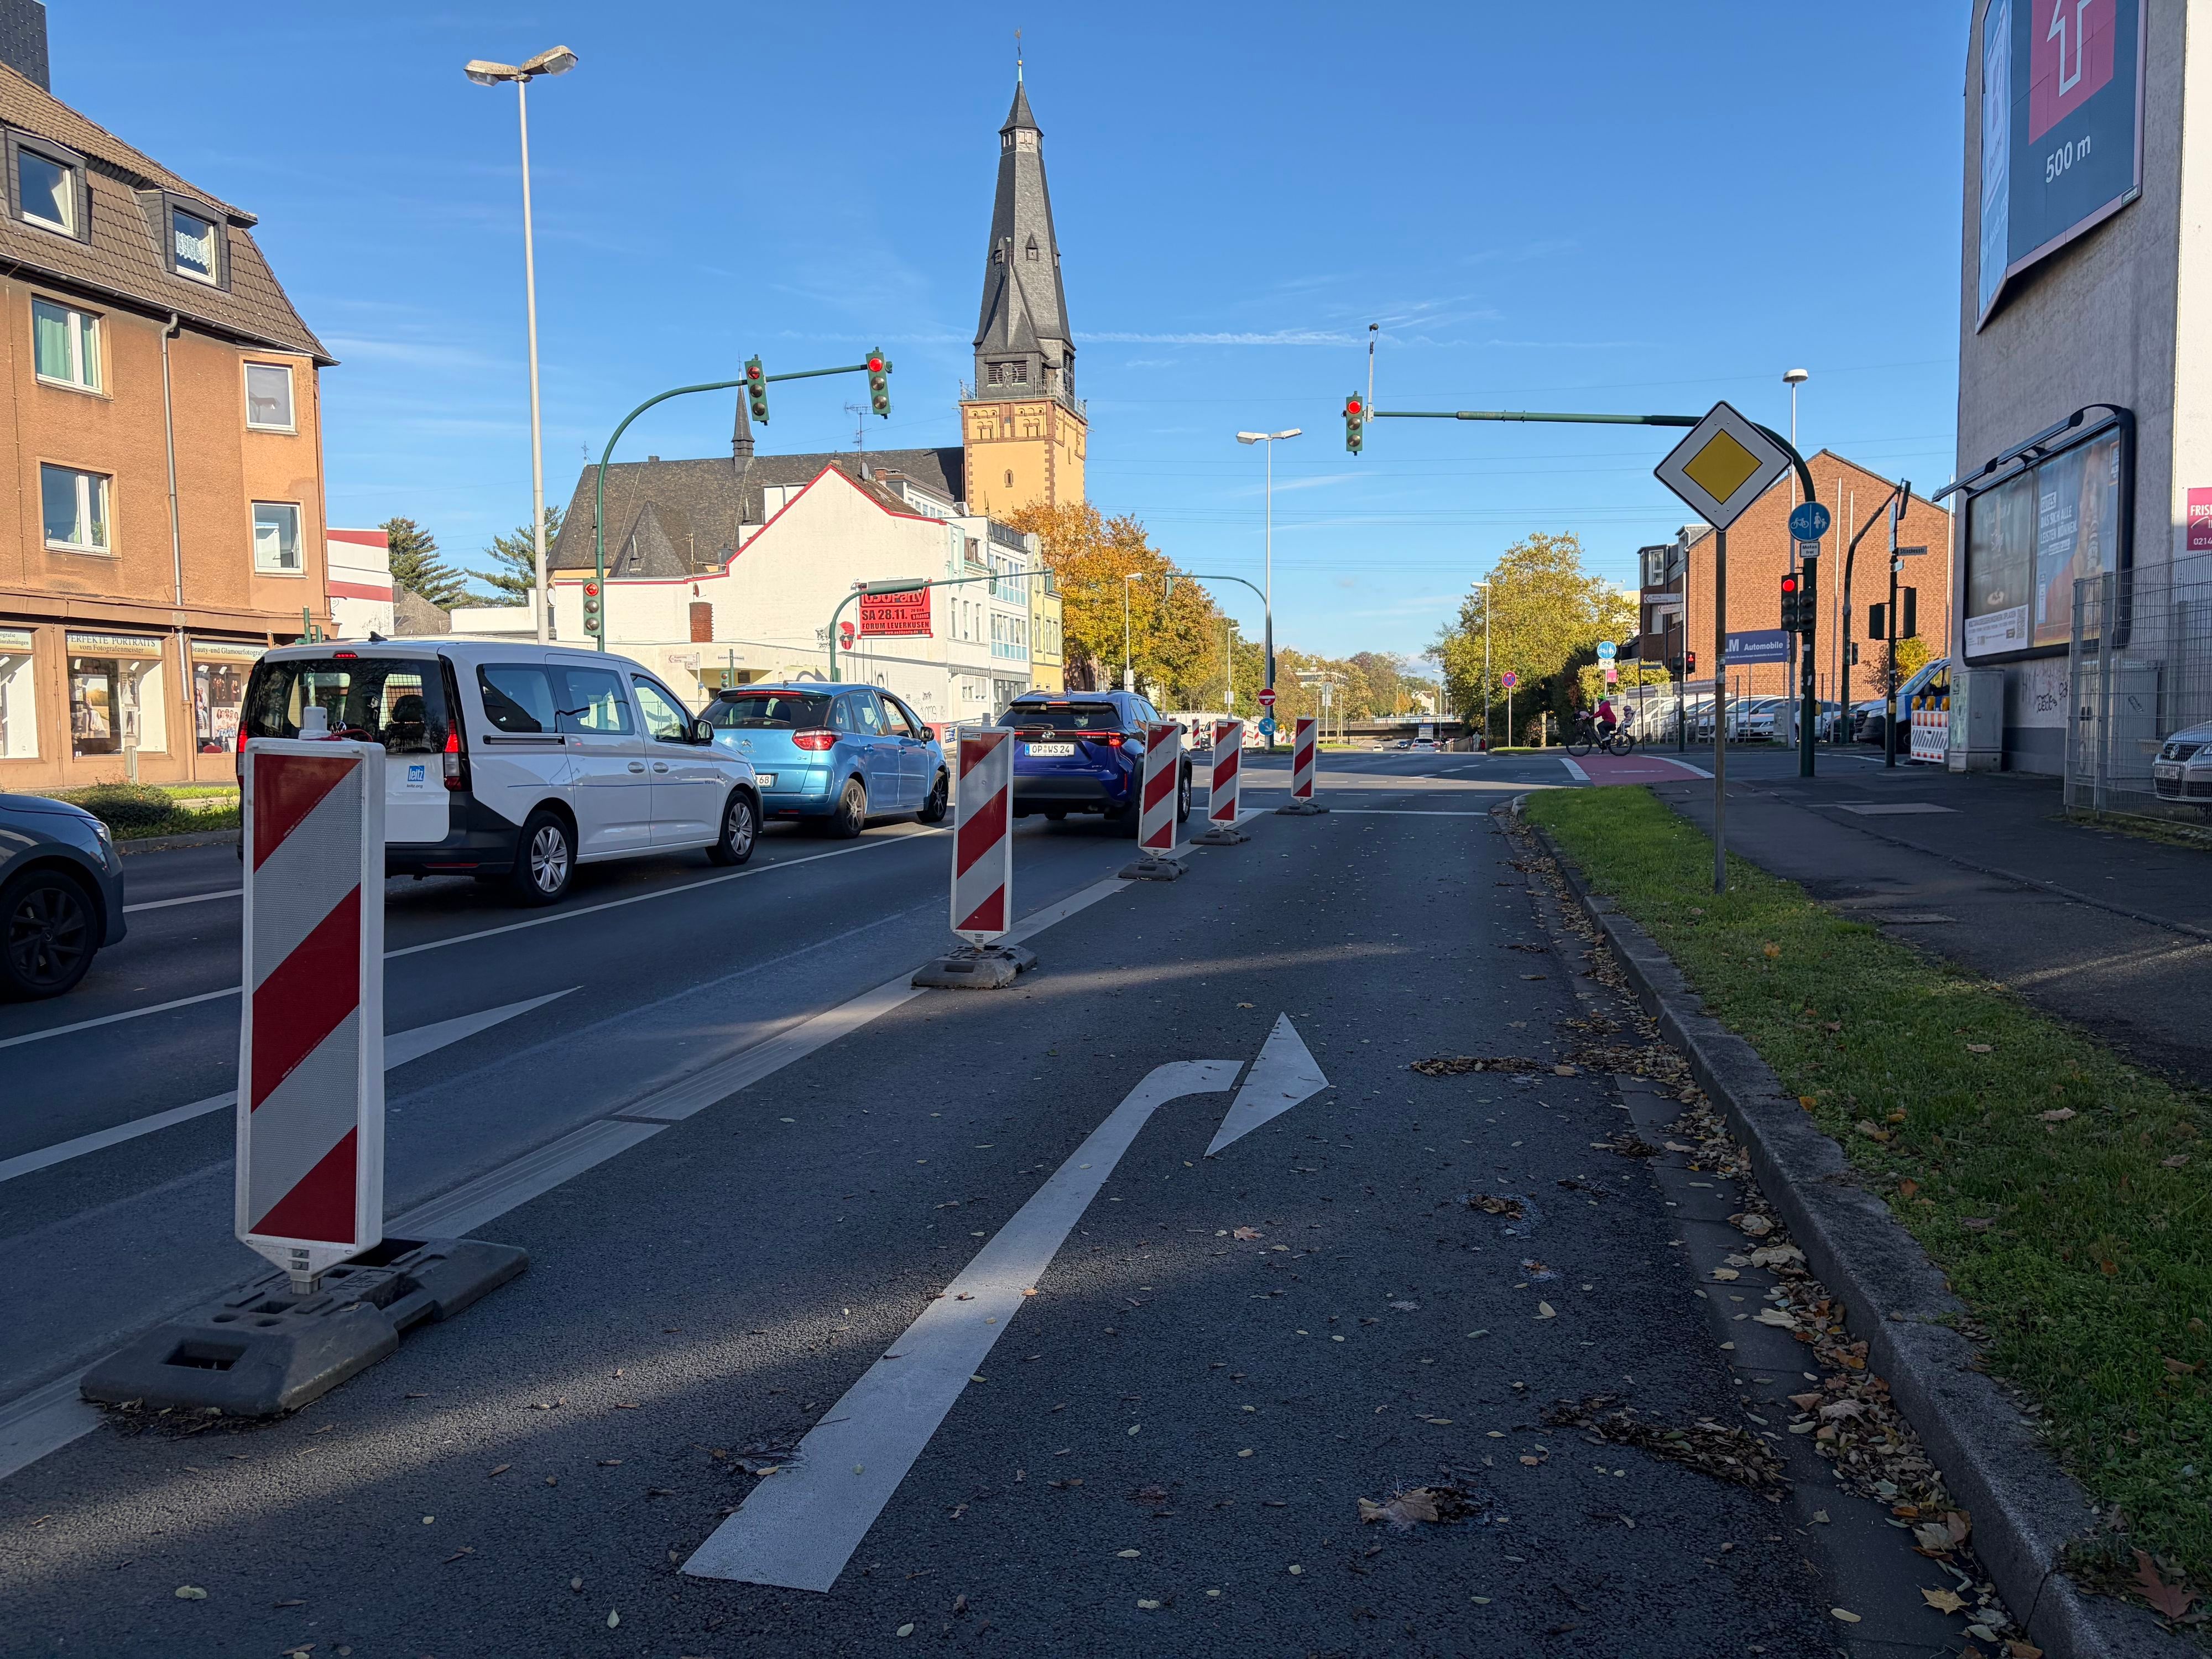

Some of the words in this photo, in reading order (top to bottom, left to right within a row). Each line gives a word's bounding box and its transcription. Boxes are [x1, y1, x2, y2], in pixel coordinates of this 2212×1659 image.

[2046, 142, 2073, 184] 500
[2077, 135, 2091, 161] m
[2041, 515, 2050, 529] DAS
[2051, 512, 2060, 526] SICH
[2060, 505, 2072, 521] ALLE
[862, 610, 876, 620] SA
[878, 609, 907, 620] 28.11.
[66, 635, 108, 644] PERFEKTE
[112, 638, 155, 647] PORTRAITS
[1744, 641, 1783, 651] Automobile
[93, 644, 144, 653] Fotografenmeister
[221, 648, 264, 657] Glamourfotografi
[1032, 745, 1042, 754] OP
[1048, 745, 1058, 754] WS
[1060, 745, 1070, 754] 24
[409, 768, 424, 780] leitz
